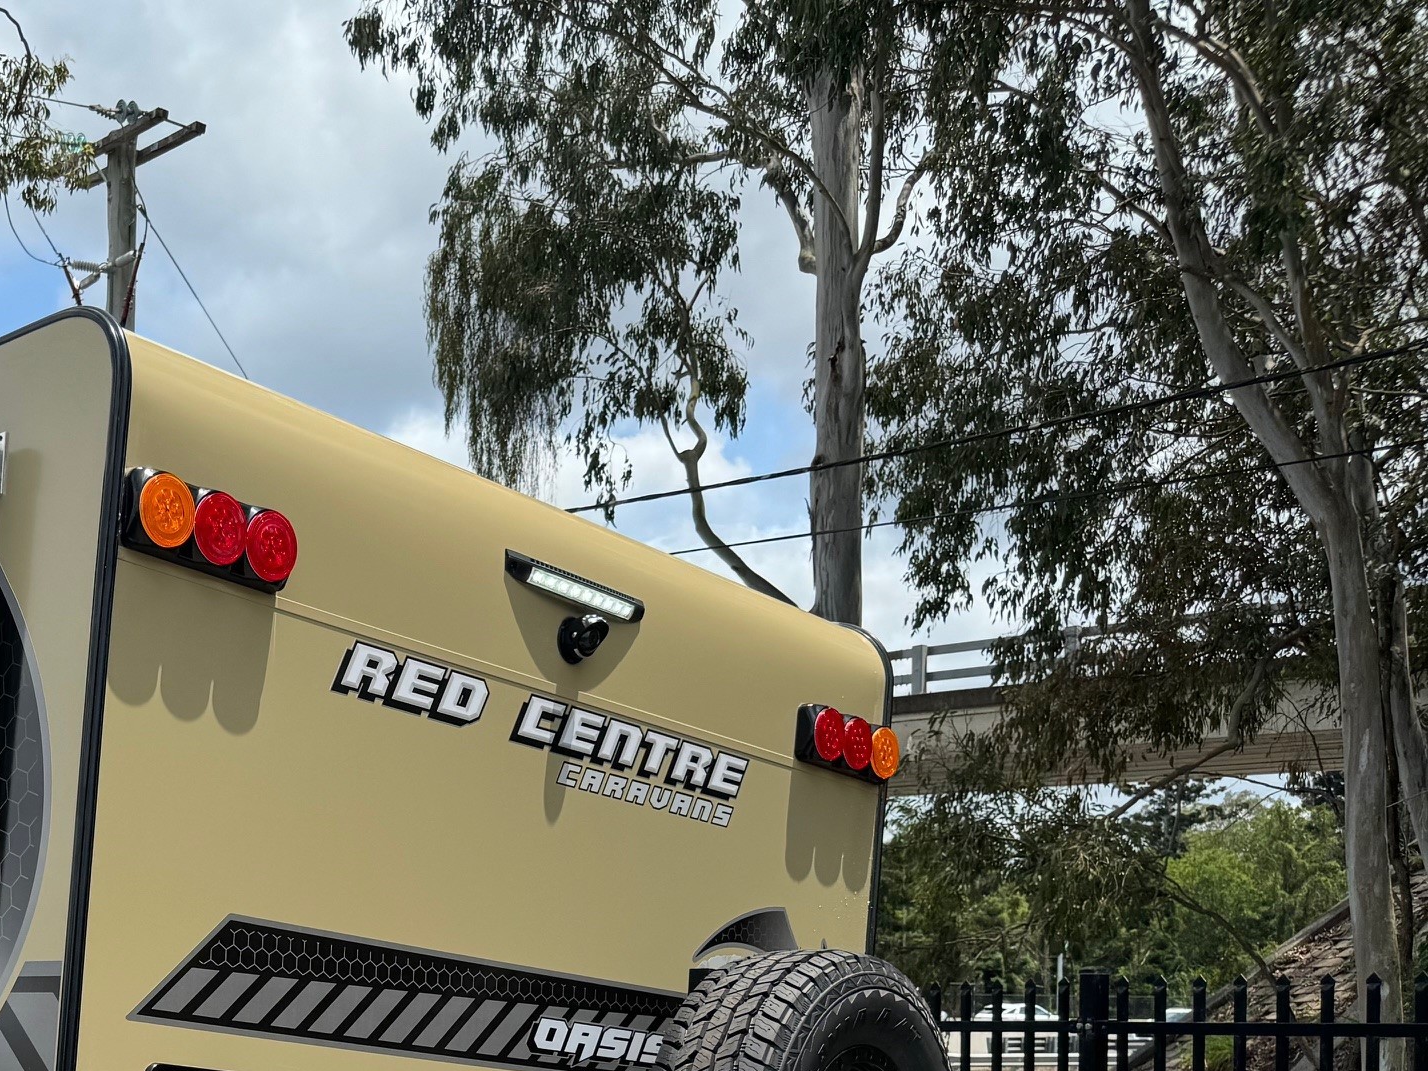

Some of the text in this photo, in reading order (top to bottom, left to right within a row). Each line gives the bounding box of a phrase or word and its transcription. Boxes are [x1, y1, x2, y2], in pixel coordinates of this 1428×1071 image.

[331, 640, 750, 801] RED CENTRE
[556, 761, 735, 828] CARAVANS
[532, 1017, 665, 1065] OASIS
